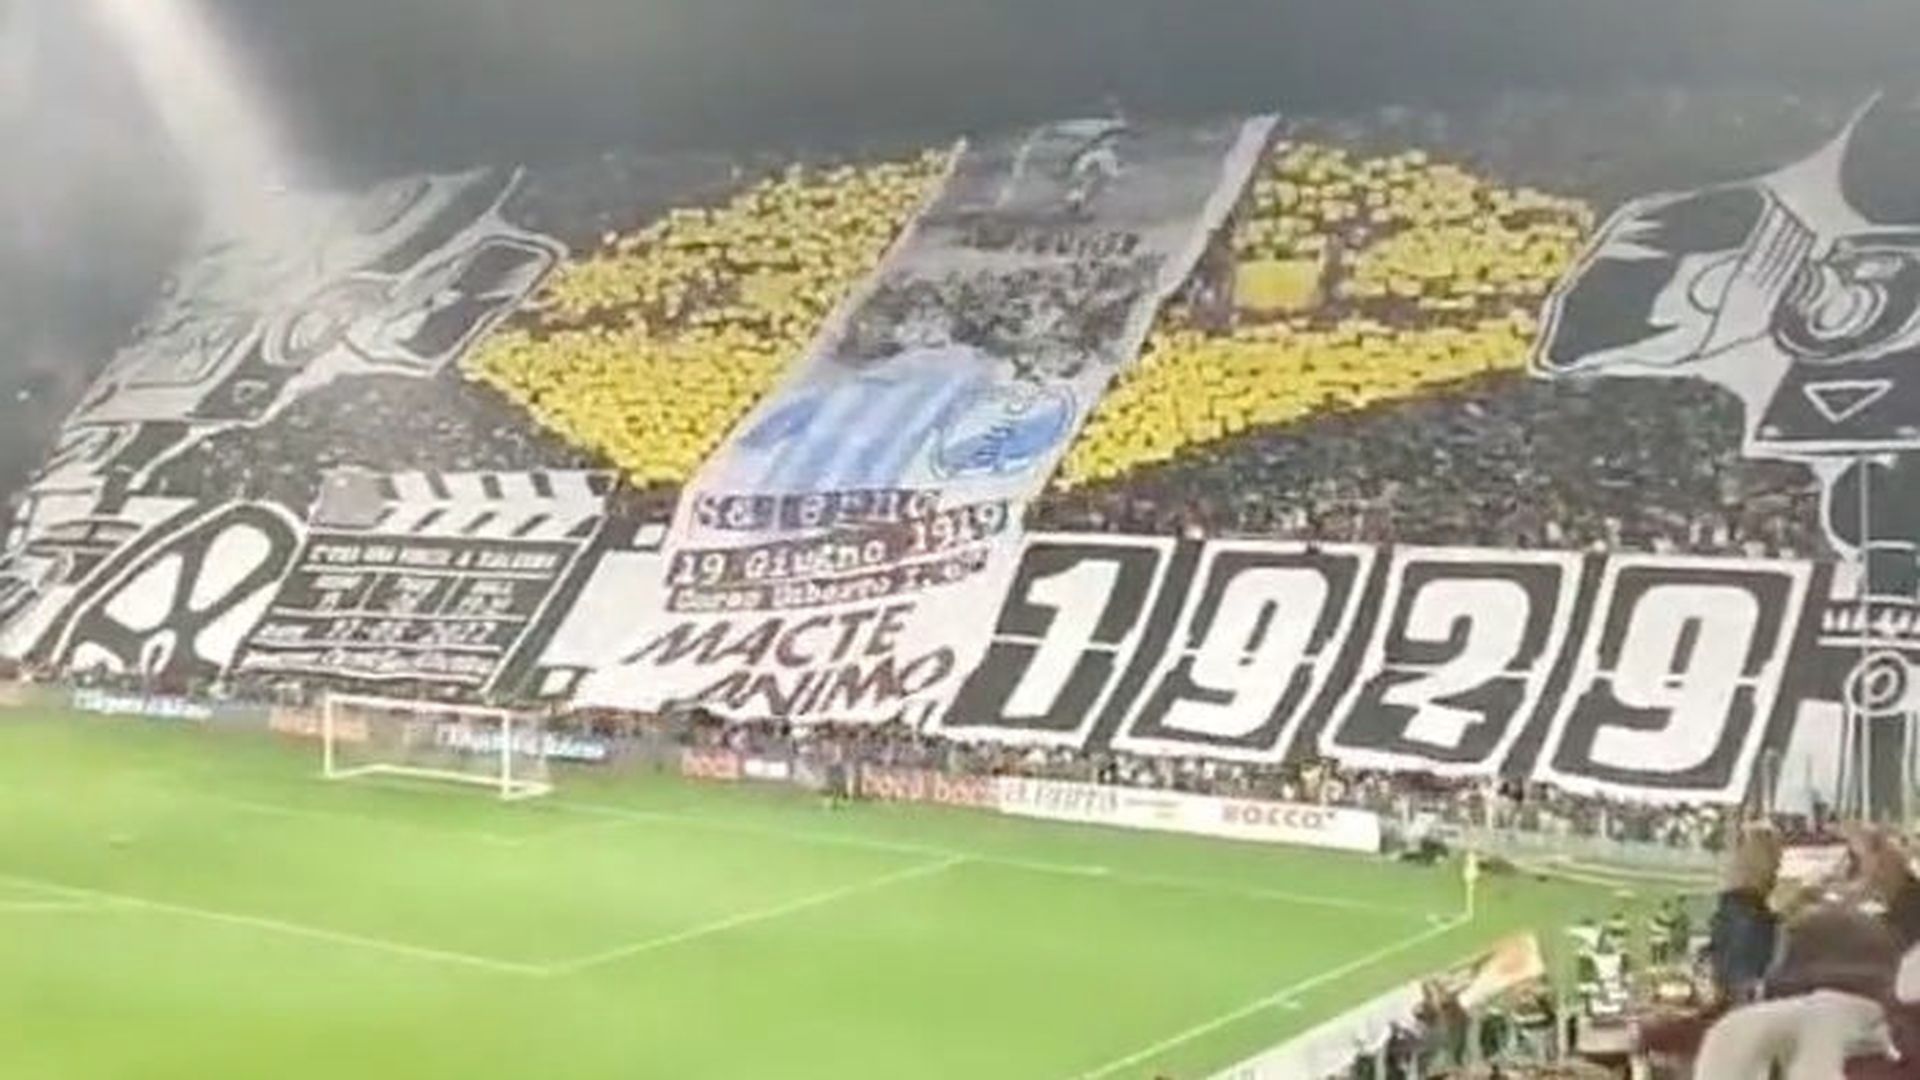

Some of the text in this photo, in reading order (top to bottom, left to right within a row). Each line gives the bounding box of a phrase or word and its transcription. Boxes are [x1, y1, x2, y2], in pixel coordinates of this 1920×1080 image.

[675, 552, 726, 586] 19
[619, 601, 917, 666] MACTE
[1000, 558, 1757, 773] 1929
[660, 645, 956, 716] ANIMO
